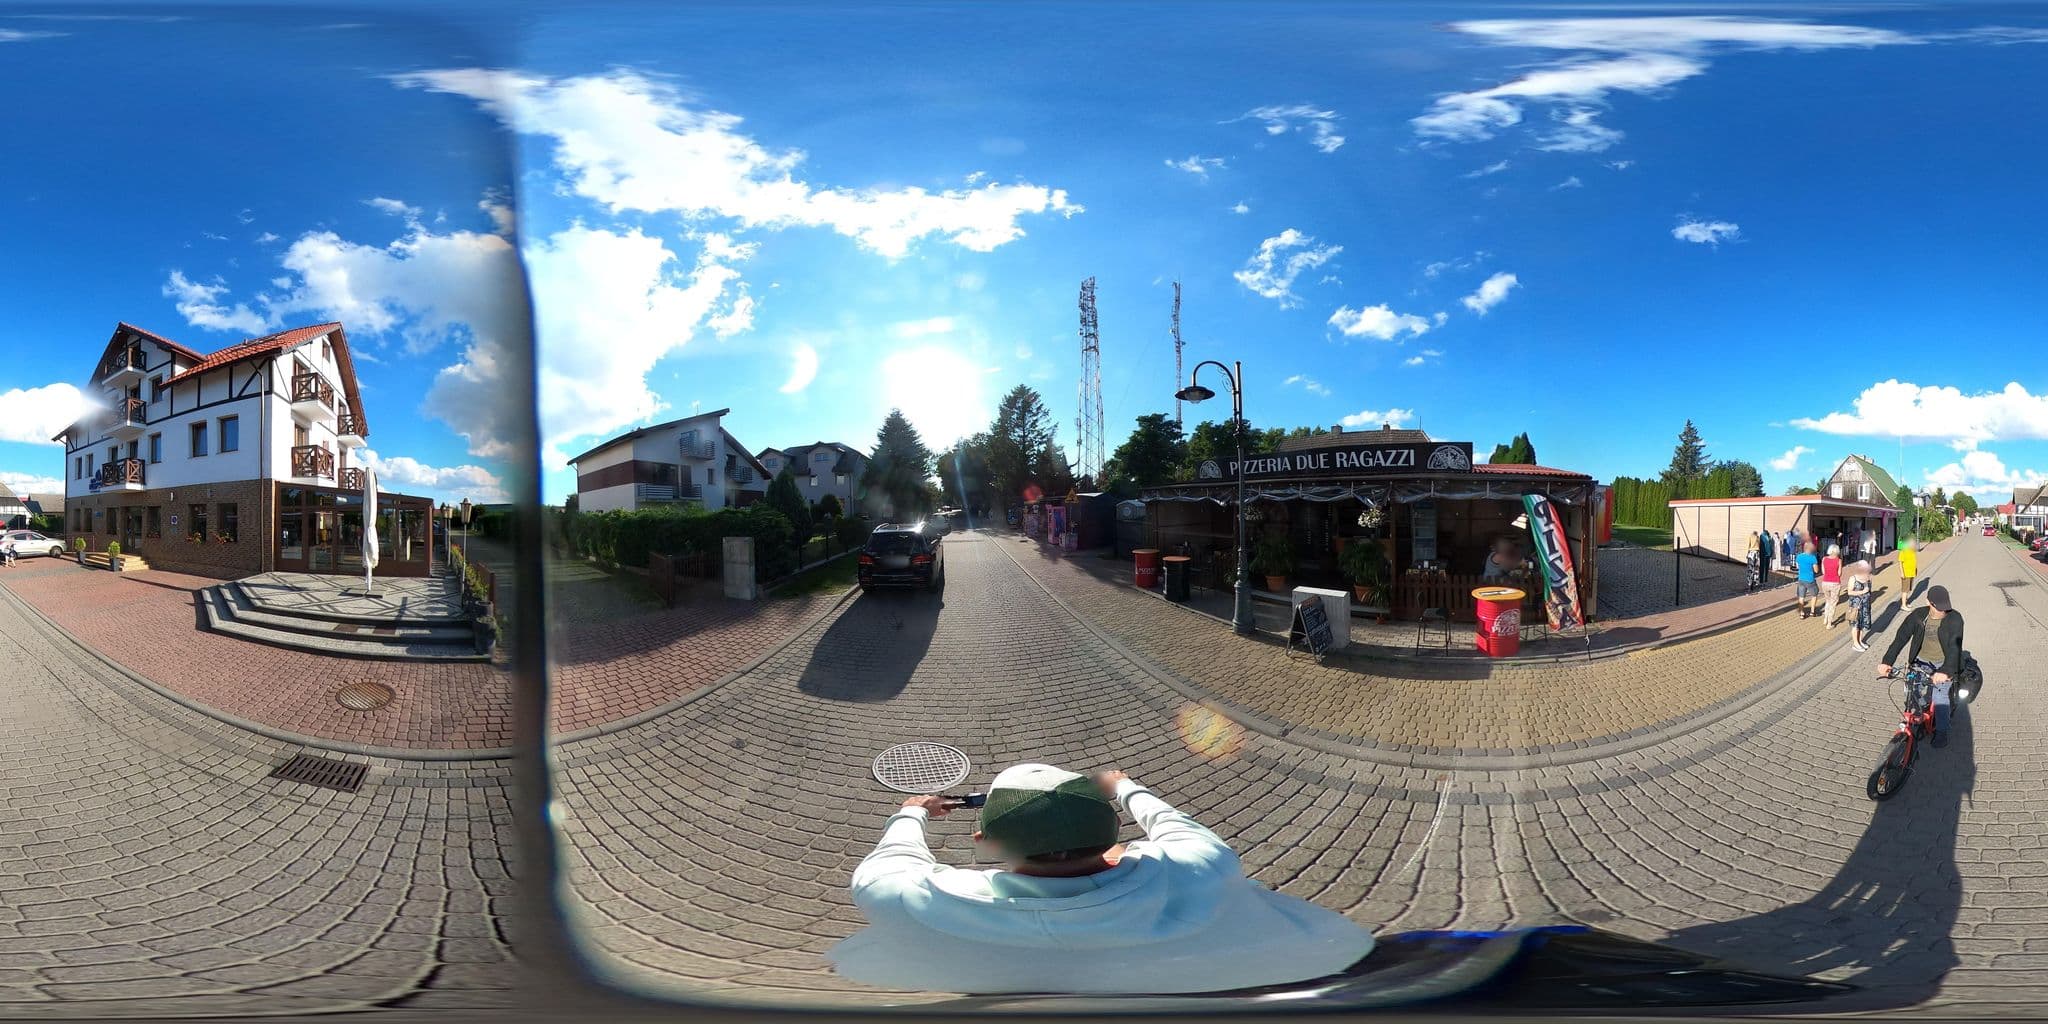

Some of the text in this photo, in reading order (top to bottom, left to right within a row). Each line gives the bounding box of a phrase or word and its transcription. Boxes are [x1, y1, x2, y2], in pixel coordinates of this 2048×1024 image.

[1230, 449, 1415, 475] PZZERIA DUE RAGAZZI
